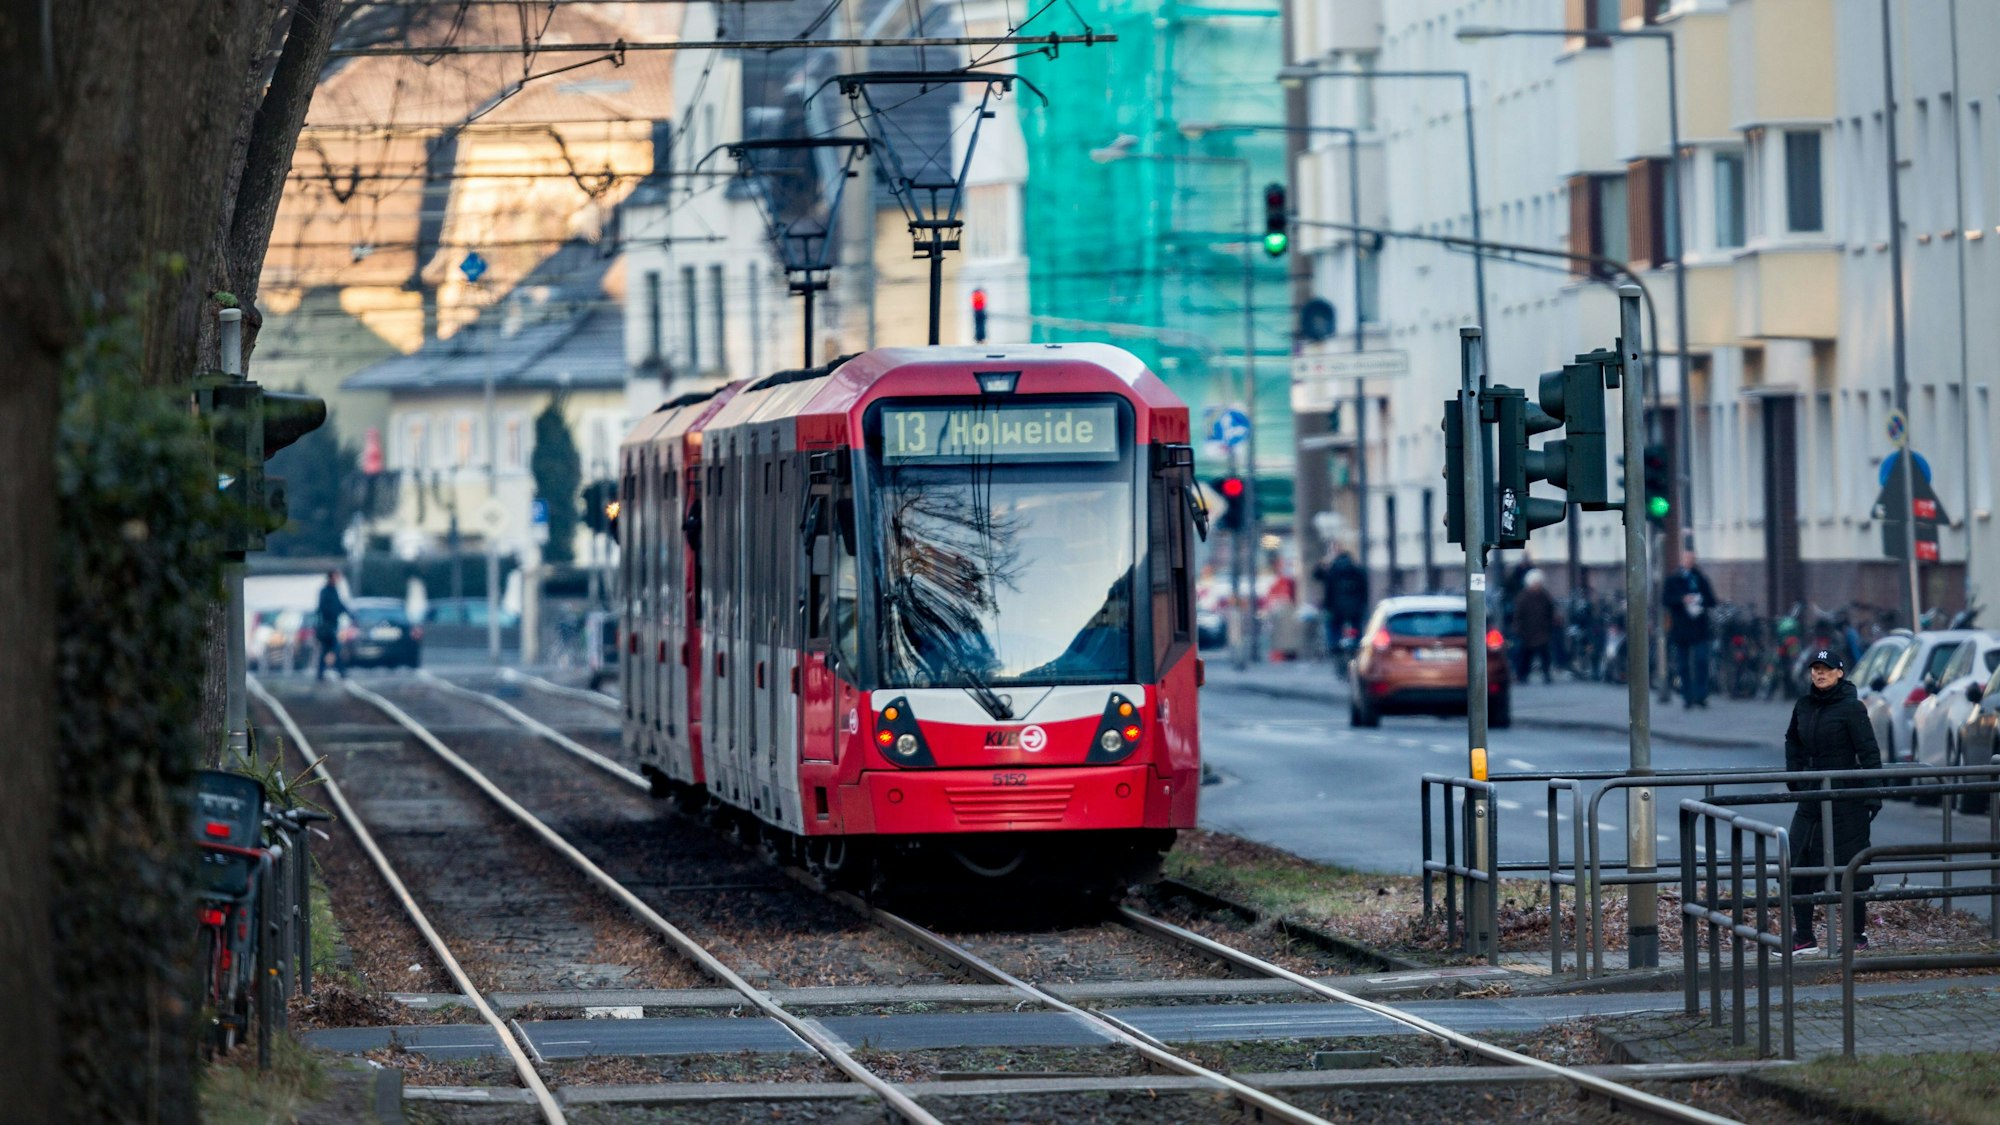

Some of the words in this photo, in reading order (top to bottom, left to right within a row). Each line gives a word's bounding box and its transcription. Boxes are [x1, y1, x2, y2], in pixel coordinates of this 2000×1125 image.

[895, 411, 926, 451] 13
[951, 411, 1094, 445] Holweide
[985, 731, 1018, 746] KVB
[992, 773, 1027, 786] 5152
